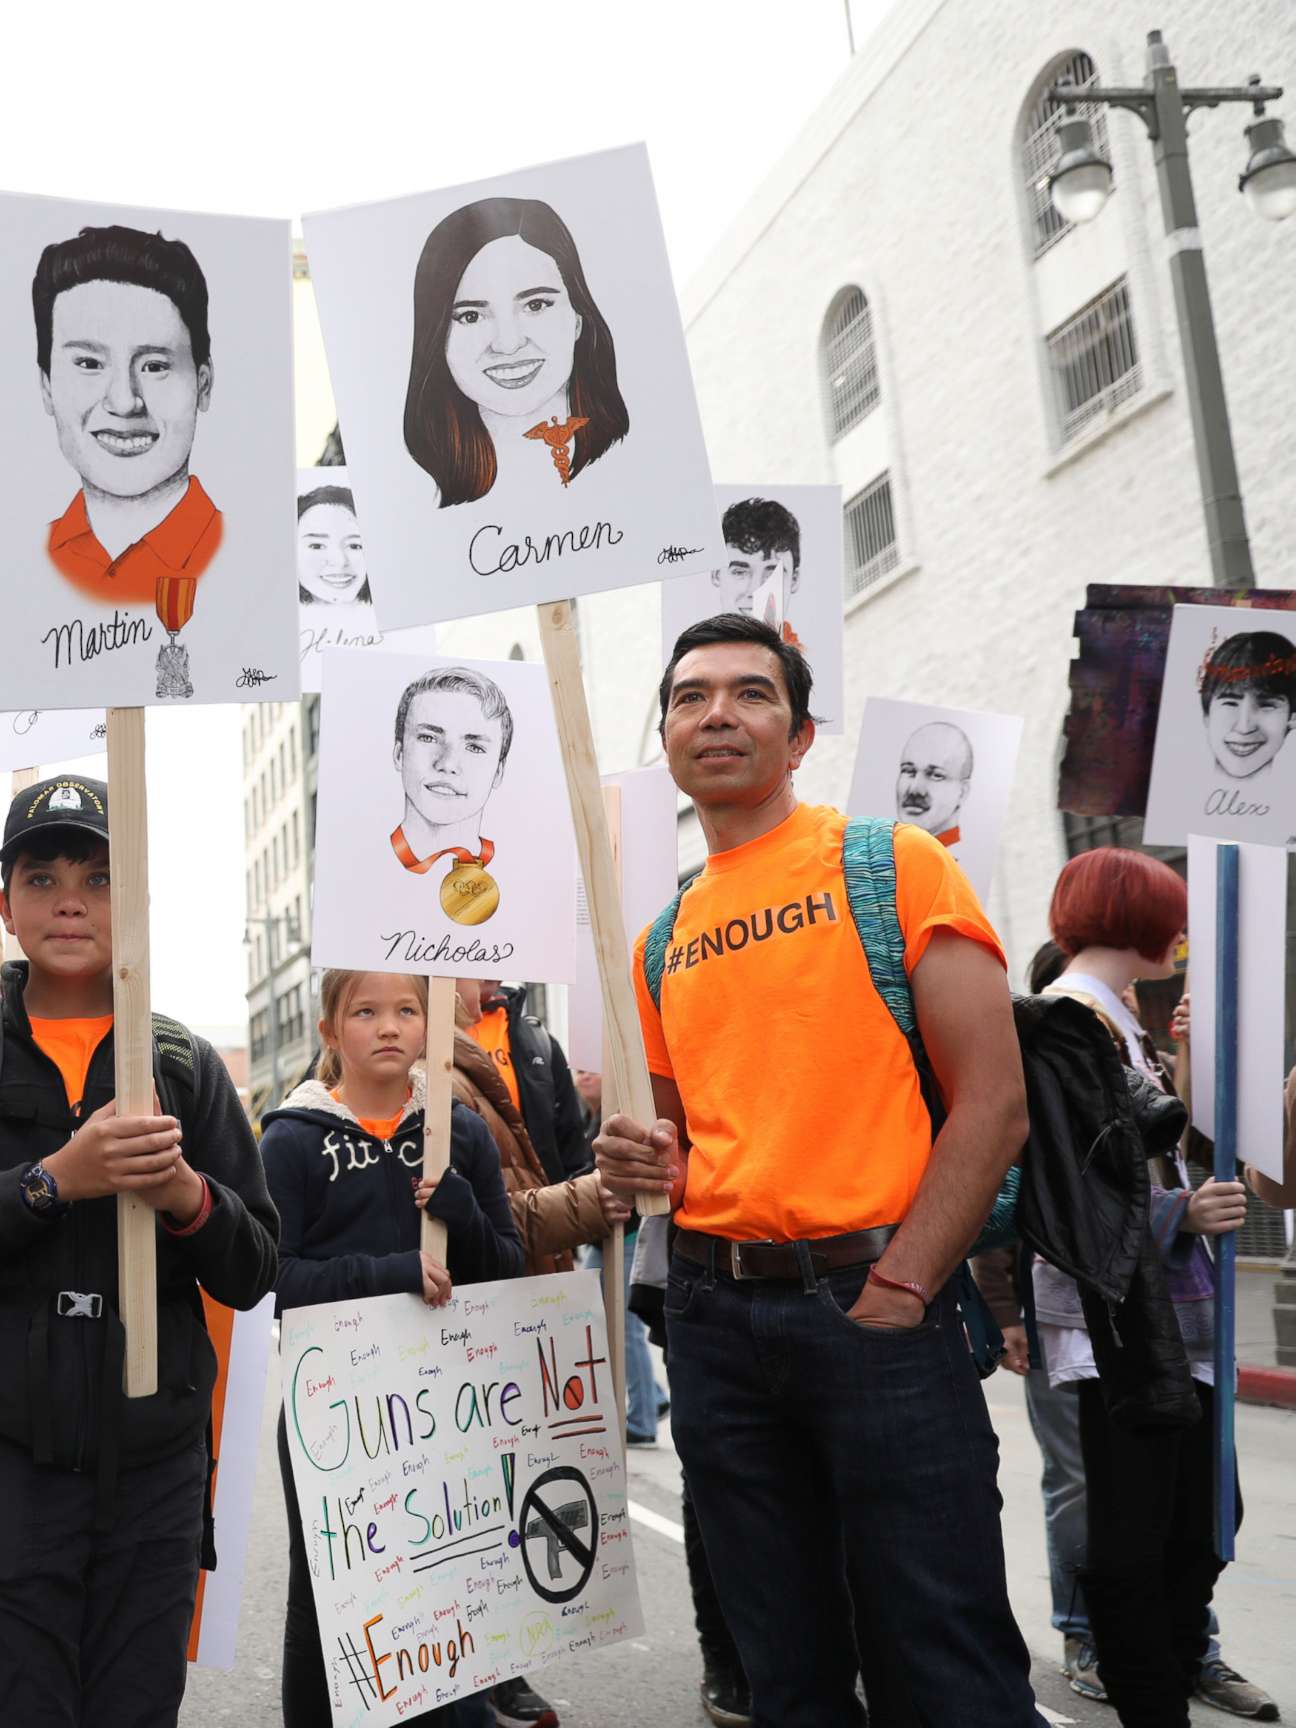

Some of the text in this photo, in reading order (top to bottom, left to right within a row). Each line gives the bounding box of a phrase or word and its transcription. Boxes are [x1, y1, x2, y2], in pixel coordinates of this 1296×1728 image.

[469, 522, 624, 577] Carmen
[41, 609, 153, 669] Martin
[1204, 788, 1270, 816] Alex
[381, 930, 515, 965] Nicholas
[667, 889, 838, 975] #ENOUGH
[350, 1344, 381, 1366] Enough
[441, 1329, 472, 1346] Enough
[291, 1325, 607, 1470] Guns are Not
[402, 1454, 430, 1476] Enough
[320, 1495, 385, 1580] the
[338, 1613, 475, 1711] #Enough
